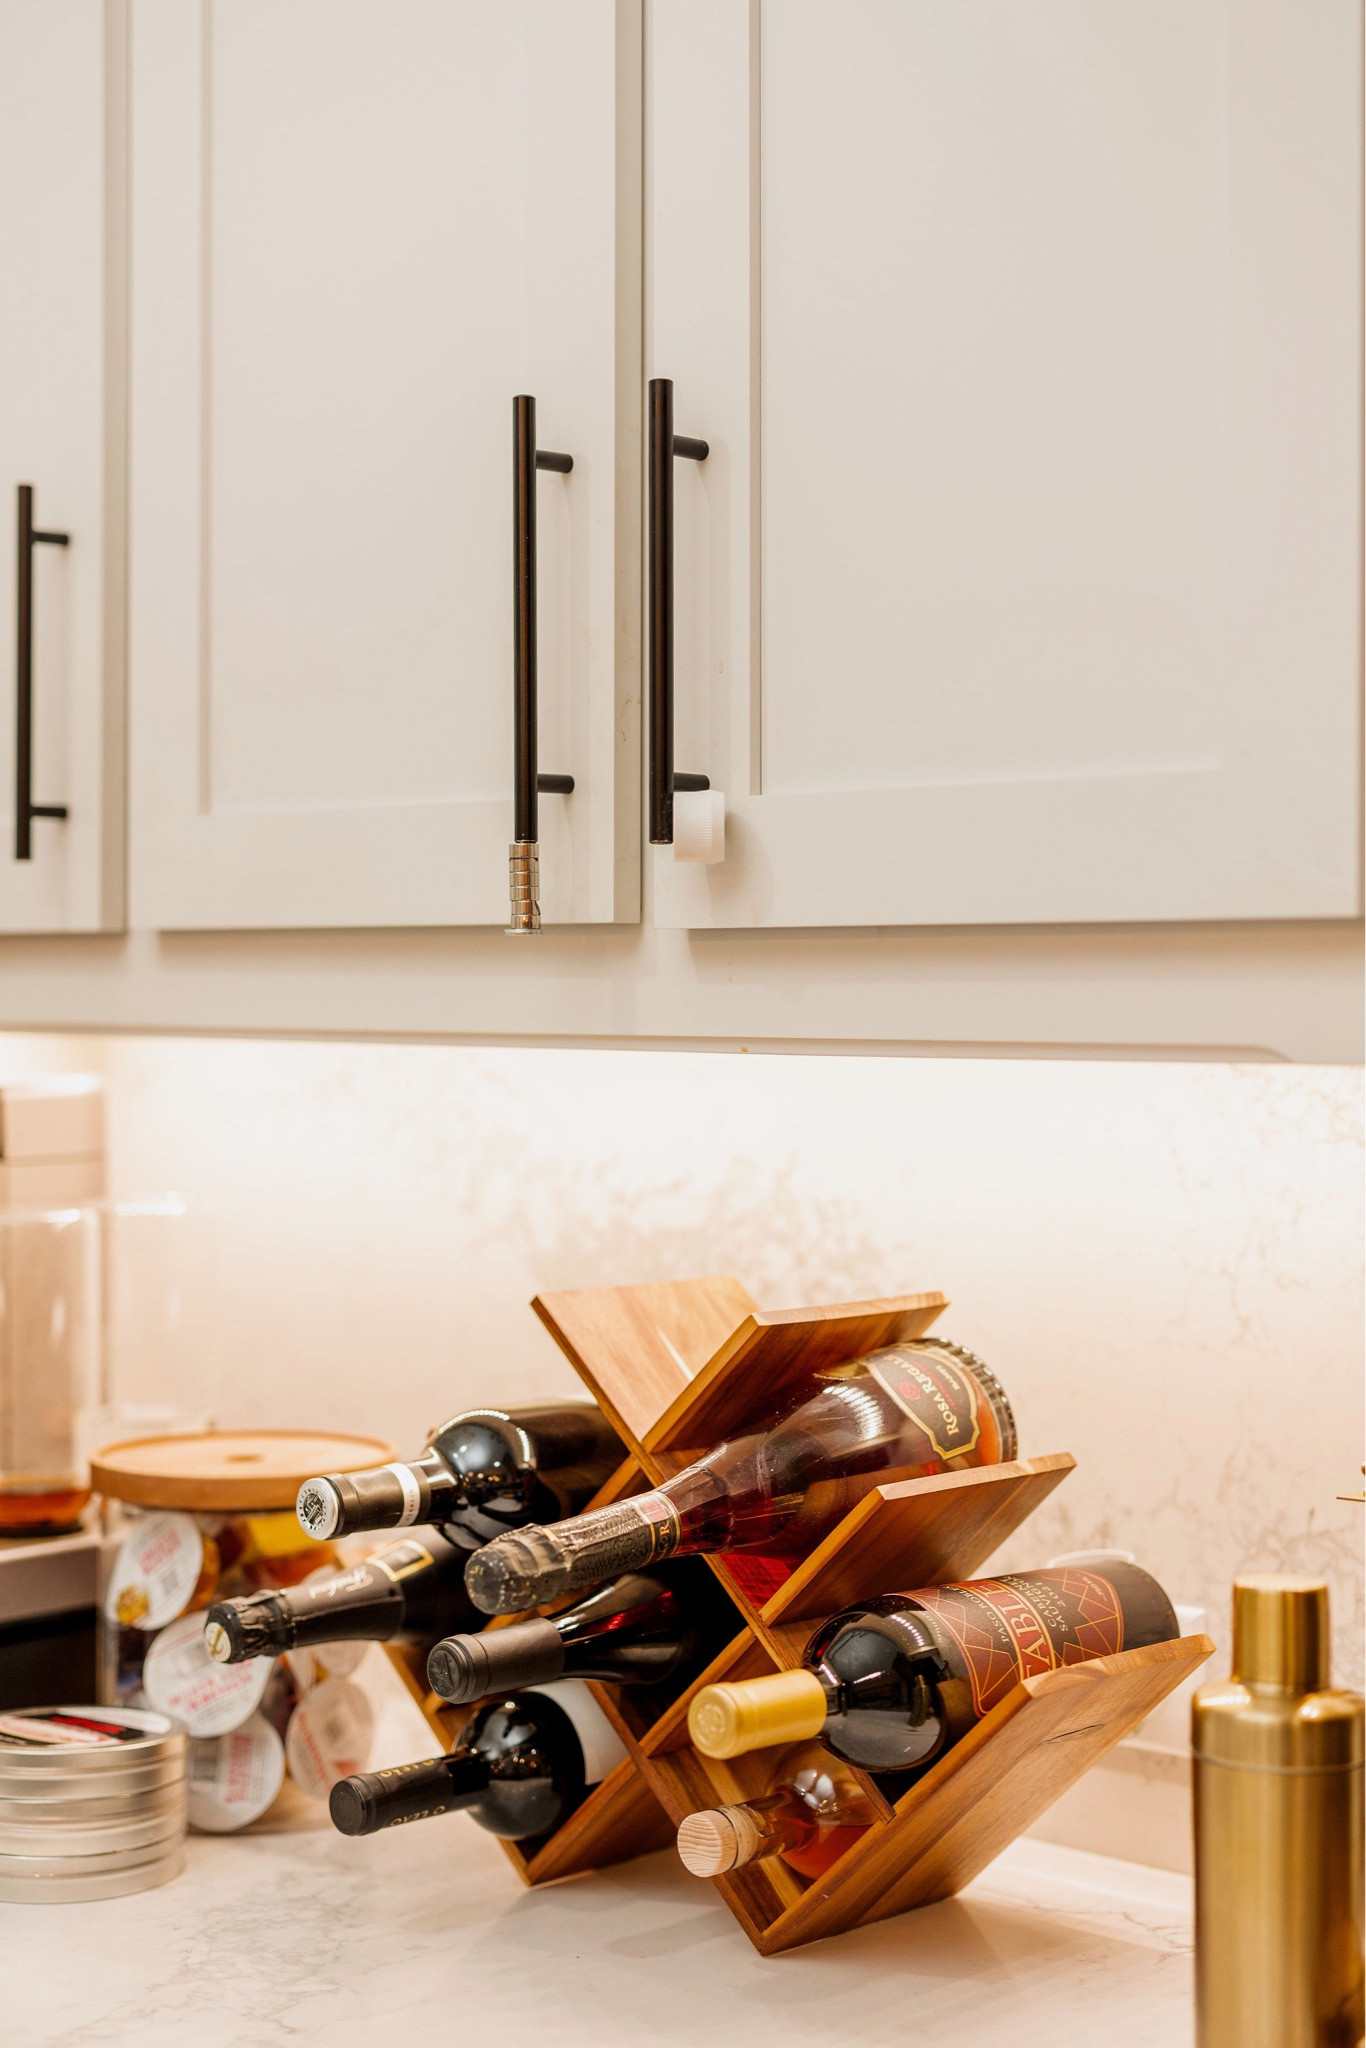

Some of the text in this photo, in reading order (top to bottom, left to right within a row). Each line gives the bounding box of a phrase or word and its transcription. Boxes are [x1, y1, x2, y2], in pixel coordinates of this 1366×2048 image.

[932, 1392, 960, 1436] ROSA
[969, 1583, 1051, 1679] ABLE
[986, 1611, 1010, 1643] PASO
